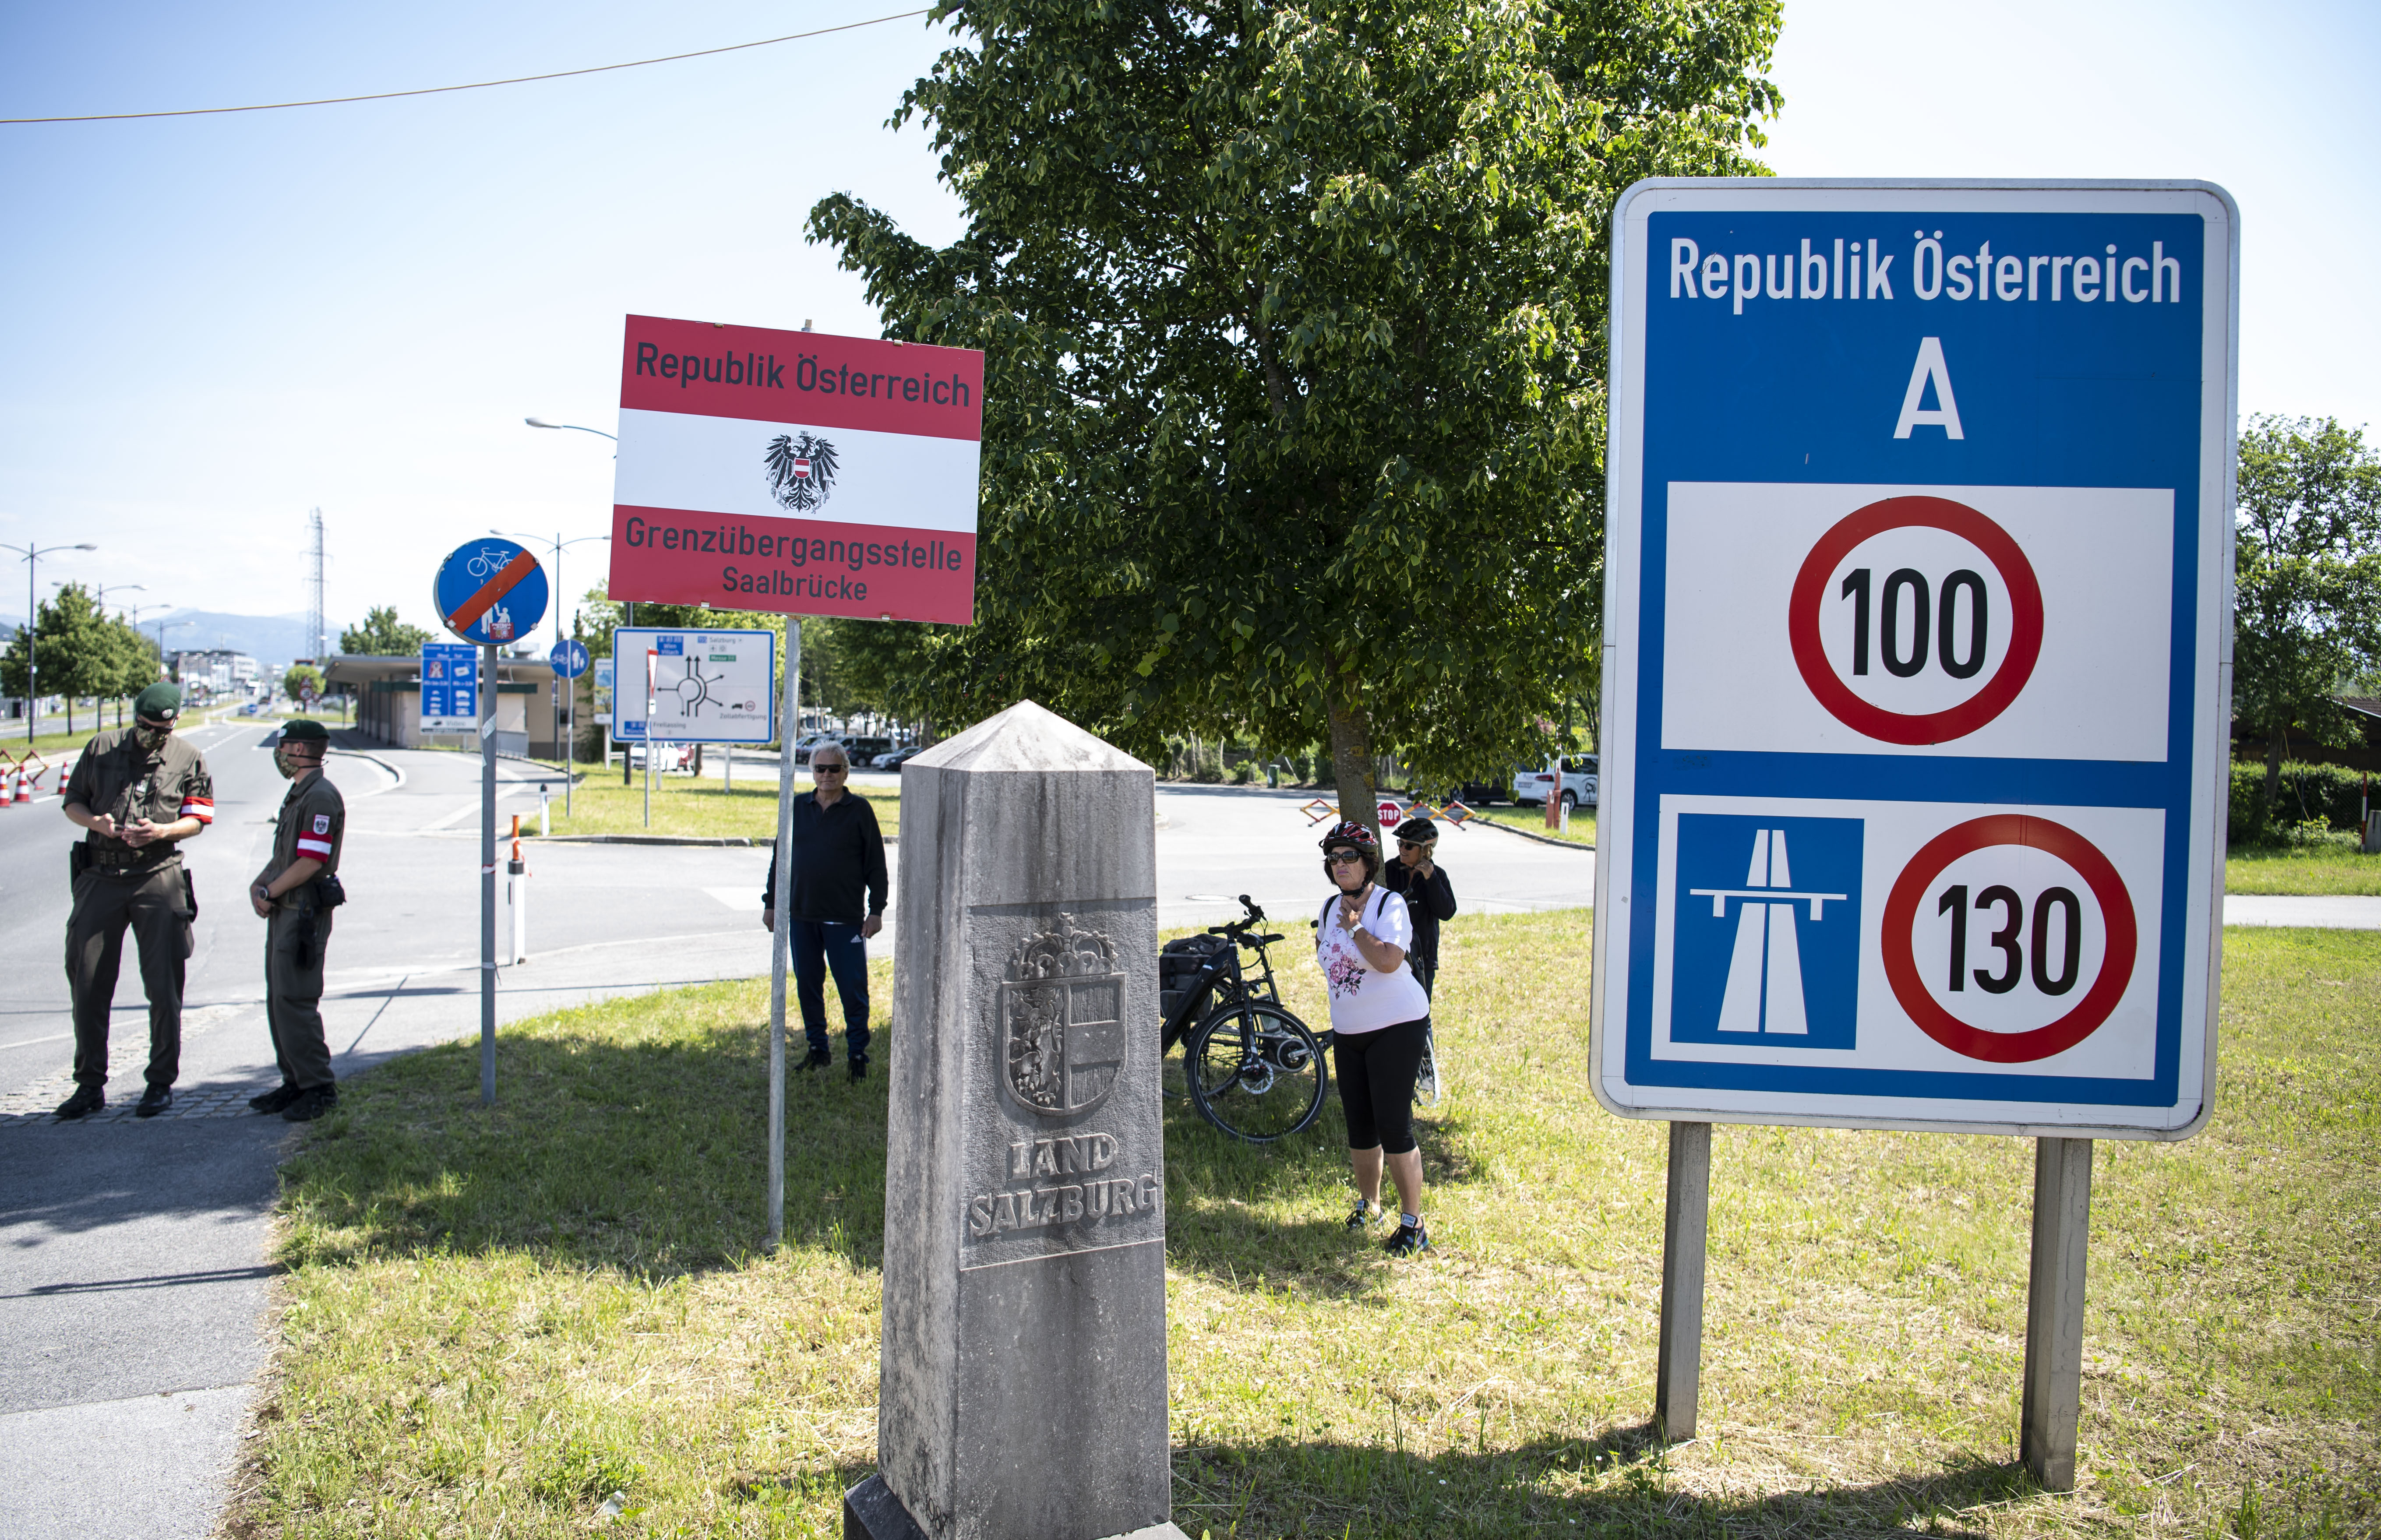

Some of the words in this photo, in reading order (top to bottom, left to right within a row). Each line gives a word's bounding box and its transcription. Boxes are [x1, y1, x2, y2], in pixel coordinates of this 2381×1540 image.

[1671, 239, 1894, 314] Republik
[1914, 230, 2180, 303] Österreich
[636, 342, 786, 389] Republik
[797, 353, 970, 407] Österreich
[1894, 337, 1964, 440] A
[626, 517, 962, 571] Grenzübergangsstelle
[723, 566, 868, 601] Saalbrücke
[1842, 568, 1988, 679] 100
[1377, 809, 1399, 821] STOP
[1938, 885, 2081, 996] 130
[1009, 1133, 1118, 1181] LAND
[970, 1170, 1157, 1239] SALZBURG
